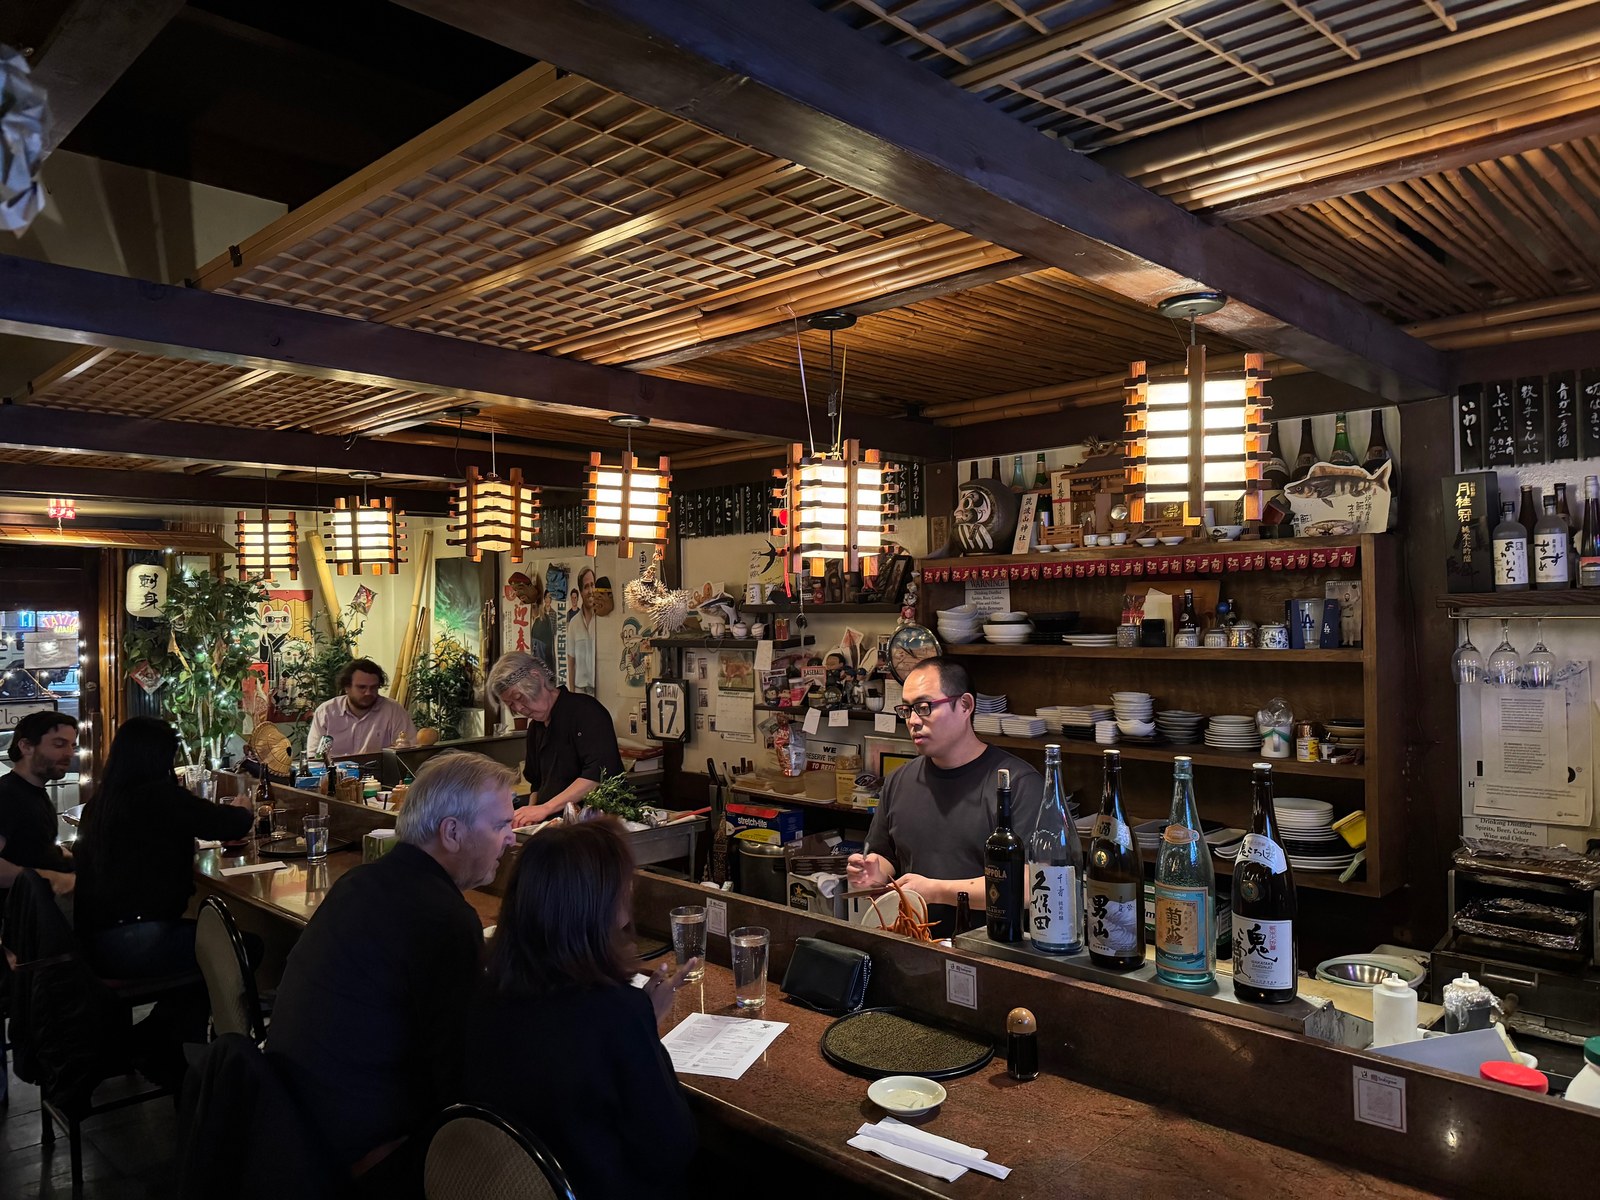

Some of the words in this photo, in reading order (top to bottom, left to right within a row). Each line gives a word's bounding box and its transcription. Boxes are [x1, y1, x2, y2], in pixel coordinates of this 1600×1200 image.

[1461, 401, 1478, 447] いわし
[1455, 481, 1472, 523] 月桂冠
[724, 497, 732, 521] たこ
[1019, 496, 1033, 541] 筑波山神社
[1186, 557, 1222, 570] 江戸前
[1227, 555, 1264, 568] 江戸前
[1270, 553, 1308, 567] 江戸前
[1312, 550, 1353, 565] 江戸前
[1010, 566, 1039, 578] 江戸前
[1043, 564, 1072, 577] 江戸前
[1075, 562, 1107, 575] 江戸前
[1110, 561, 1143, 574] 江戸前
[1147, 559, 1181, 572] 江戸前
[924, 571, 949, 582] 江戸前
[951, 569, 978, 581] 江戸前
[981, 567, 1009, 579] 江戸前
[138, 572, 160, 610] 刺身
[1300, 610, 1315, 629] LA
[558, 634, 567, 685] FATHER
[803, 669, 823, 677] BASEBALL
[657, 699, 678, 734] 17
[823, 745, 837, 754] WE
[737, 817, 768, 828] stretch-tite
[1480, 818, 1506, 827] Drinking
[1475, 824, 1495, 833] Spirits,
[1496, 827, 1511, 835] Beer,
[1513, 829, 1537, 838] Coolers,
[1483, 832, 1499, 840] Wine
[1511, 835, 1530, 844] Other
[1030, 870, 1051, 930] 久保田
[1091, 894, 1109, 939] 男山
[1165, 907, 1184, 941] 菊水
[1247, 923, 1278, 963] 鬼
